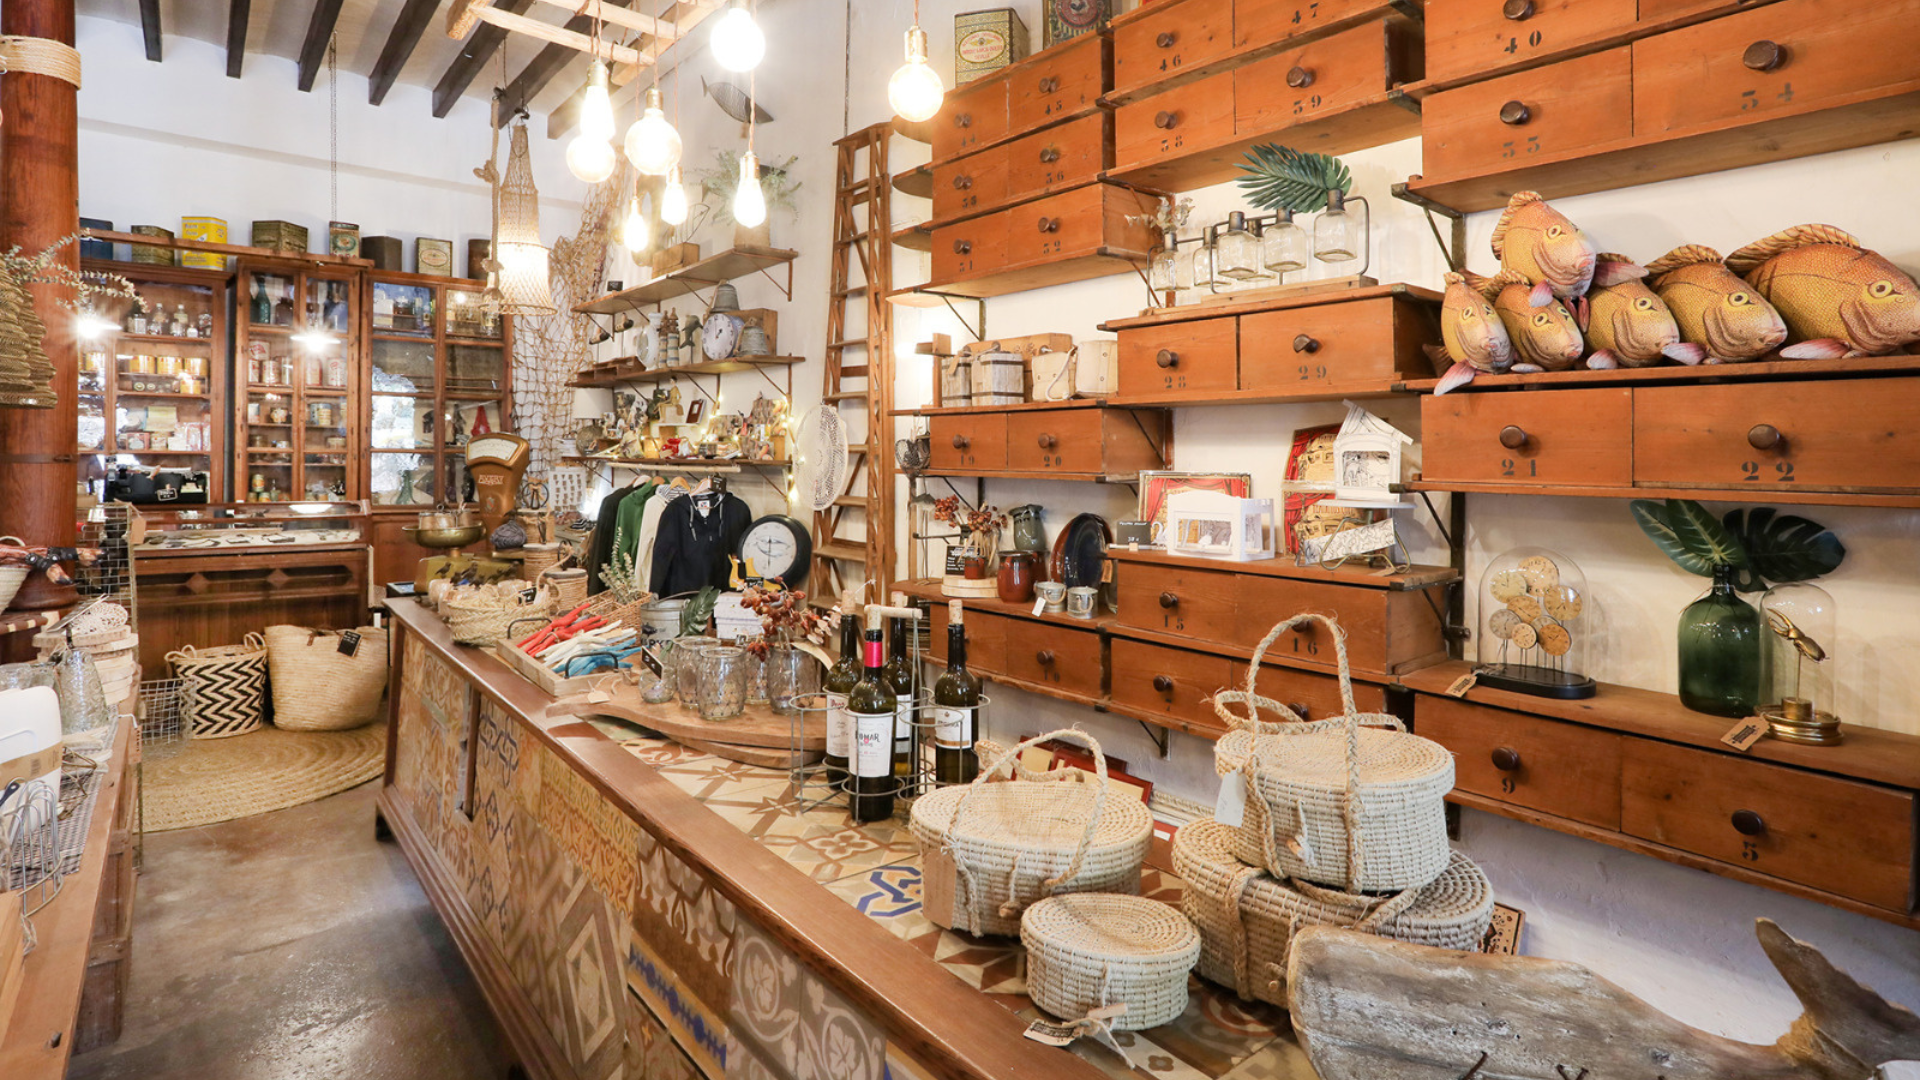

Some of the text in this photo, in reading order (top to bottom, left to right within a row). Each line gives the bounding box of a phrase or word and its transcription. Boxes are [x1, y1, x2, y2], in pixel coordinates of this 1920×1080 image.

[1291, 2, 1319, 24] 47
[1504, 29, 1542, 54] 40
[1159, 54, 1182, 72] 46
[1045, 100, 1062, 115] 45
[1297, 364, 1327, 380] 29
[1164, 375, 1187, 389] 28
[960, 454, 975, 466] 19
[1043, 455, 1062, 468] 20
[1501, 458, 1537, 477] 21
[1741, 460, 1795, 482] 22
[1164, 614, 1185, 632] 15
[1293, 636, 1319, 656] 16
[1501, 776, 1516, 794] 9
[1741, 840, 1759, 862] 5
